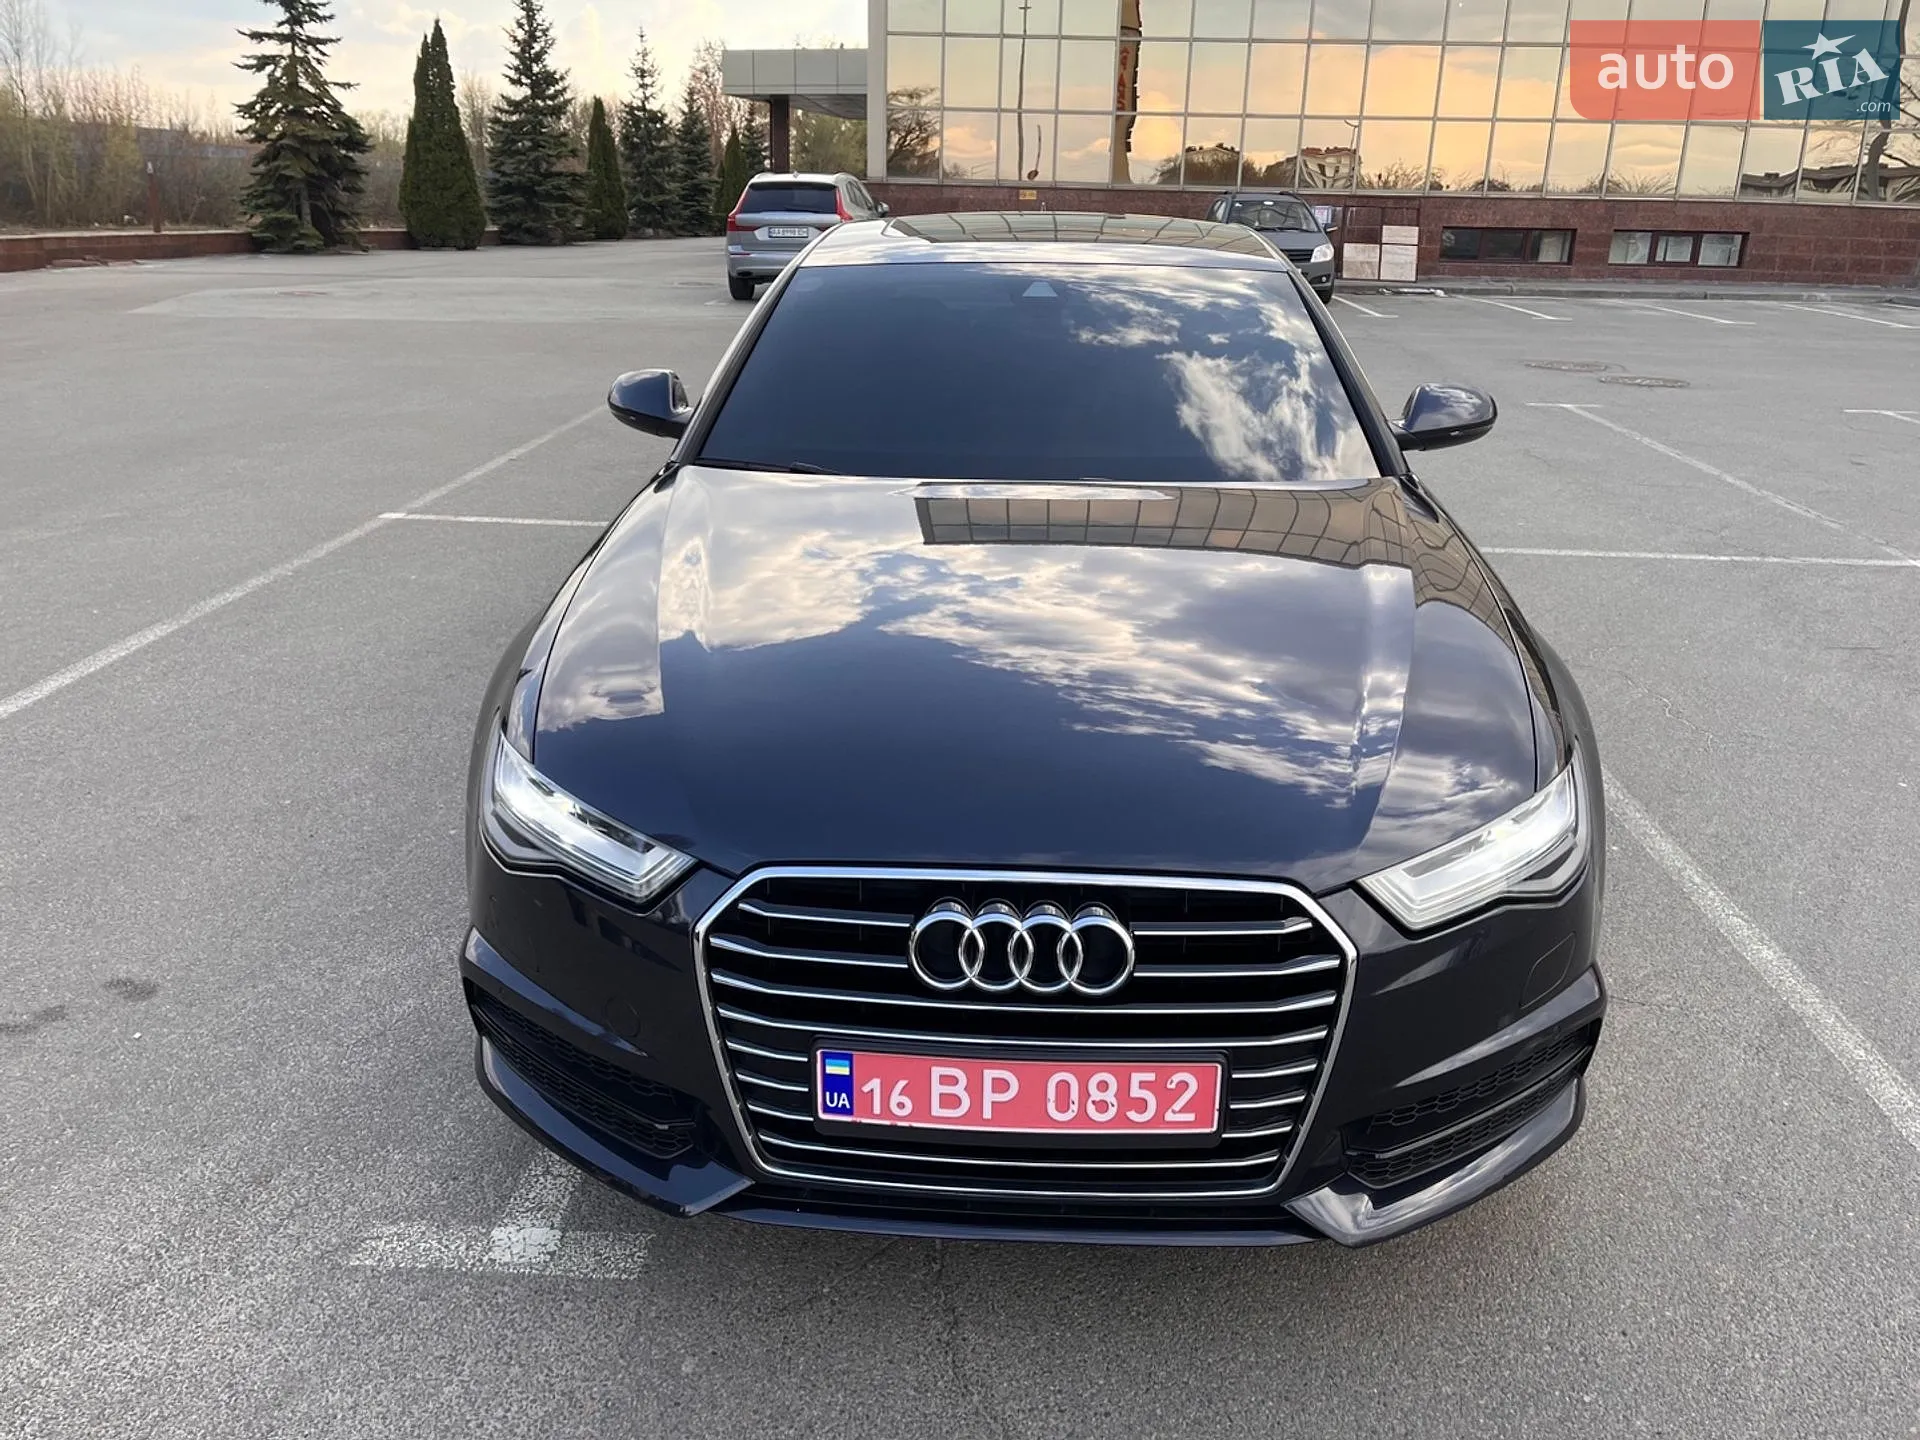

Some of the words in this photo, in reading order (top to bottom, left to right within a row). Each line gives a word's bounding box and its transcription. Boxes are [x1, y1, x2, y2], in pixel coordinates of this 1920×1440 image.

[825, 1092, 851, 1109] UA
[861, 1077, 914, 1117] 16
[930, 1066, 1020, 1121] BP
[1047, 1071, 1199, 1123] 0852
